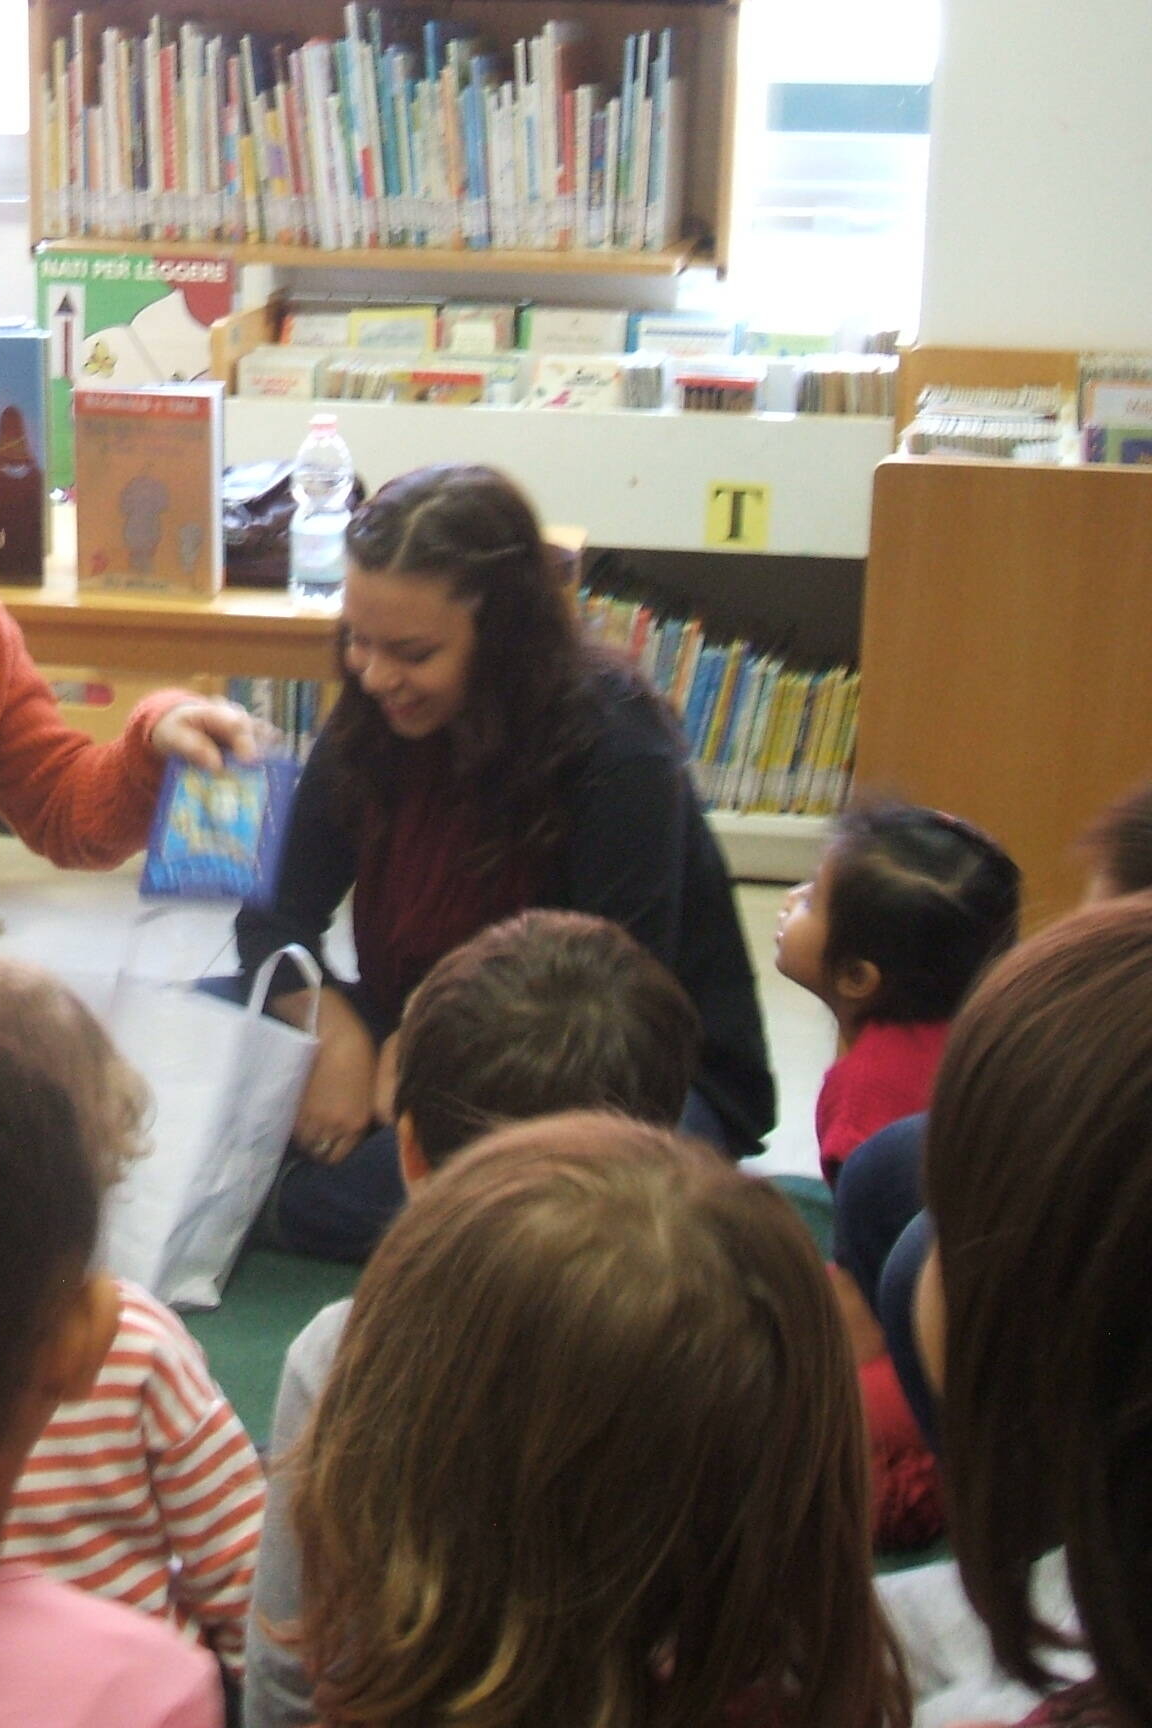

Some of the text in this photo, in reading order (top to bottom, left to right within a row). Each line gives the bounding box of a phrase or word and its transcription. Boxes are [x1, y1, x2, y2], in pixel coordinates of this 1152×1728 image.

[41, 258, 228, 282] NATI PER LEGGERE
[714, 487, 763, 541] T
